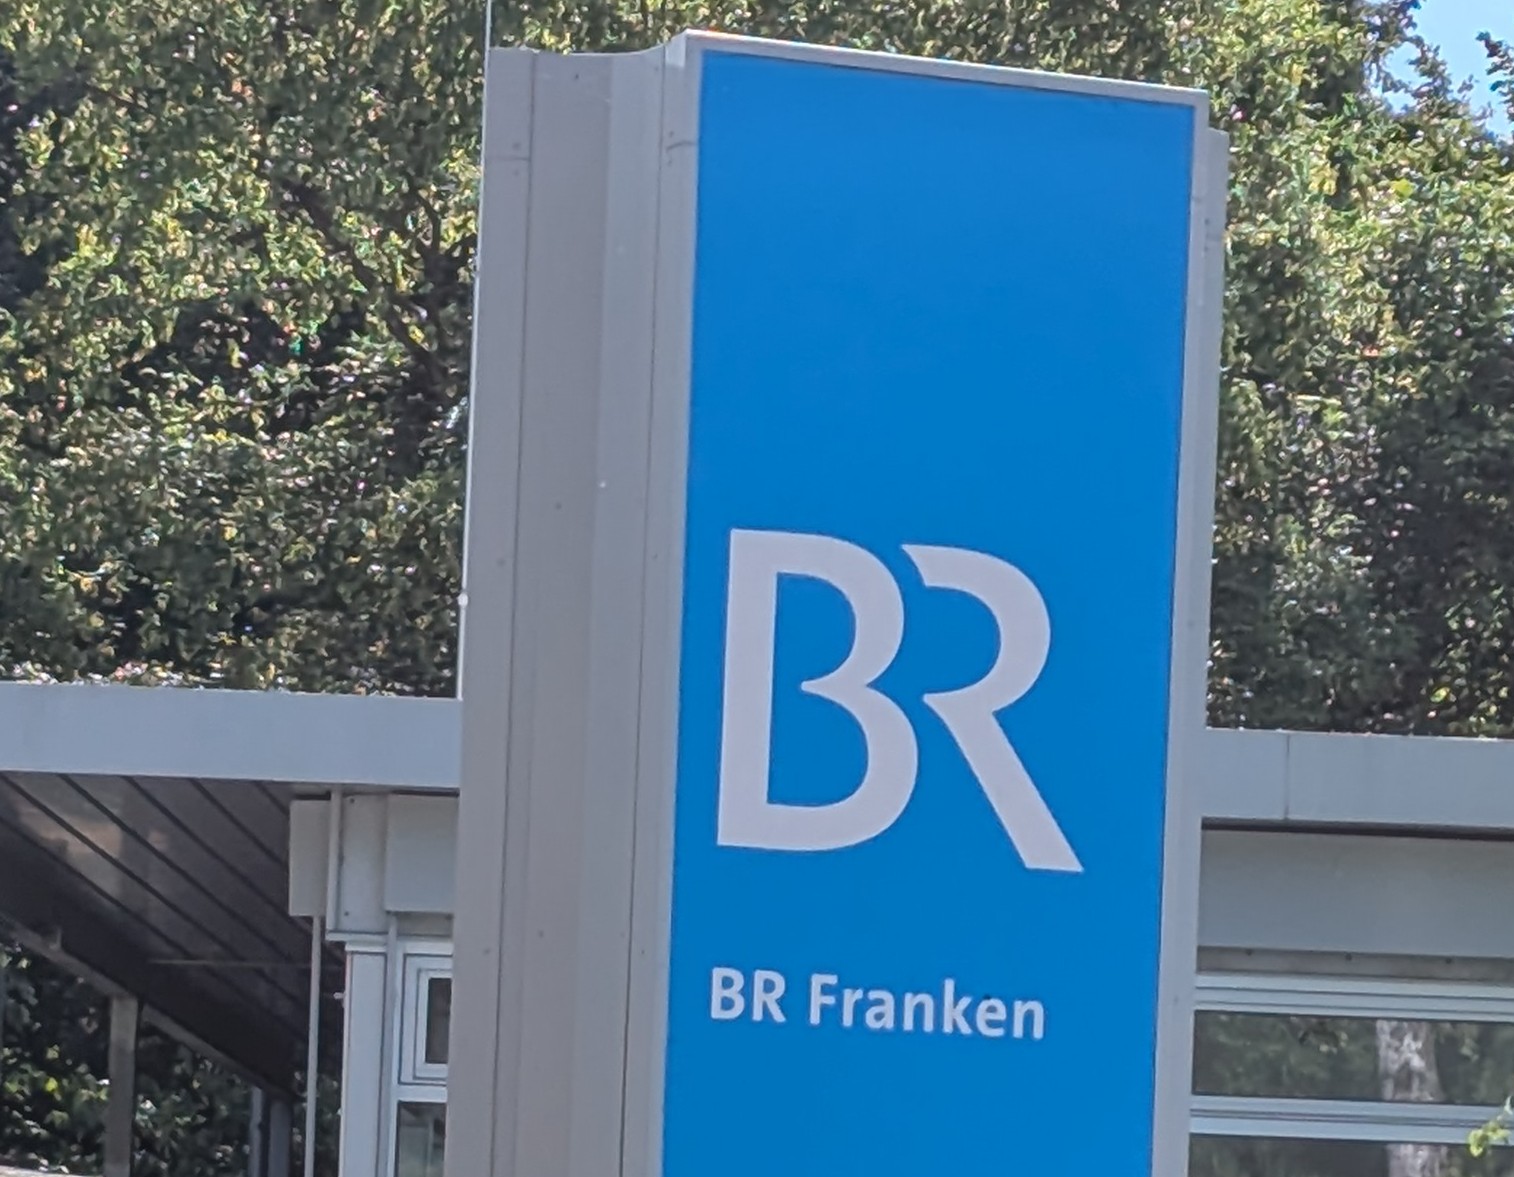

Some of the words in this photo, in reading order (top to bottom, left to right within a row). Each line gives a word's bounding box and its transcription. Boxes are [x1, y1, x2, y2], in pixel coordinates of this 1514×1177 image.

[716, 527, 1084, 873] BR
[710, 966, 787, 1024] BR
[808, 972, 1046, 1041] Franken
